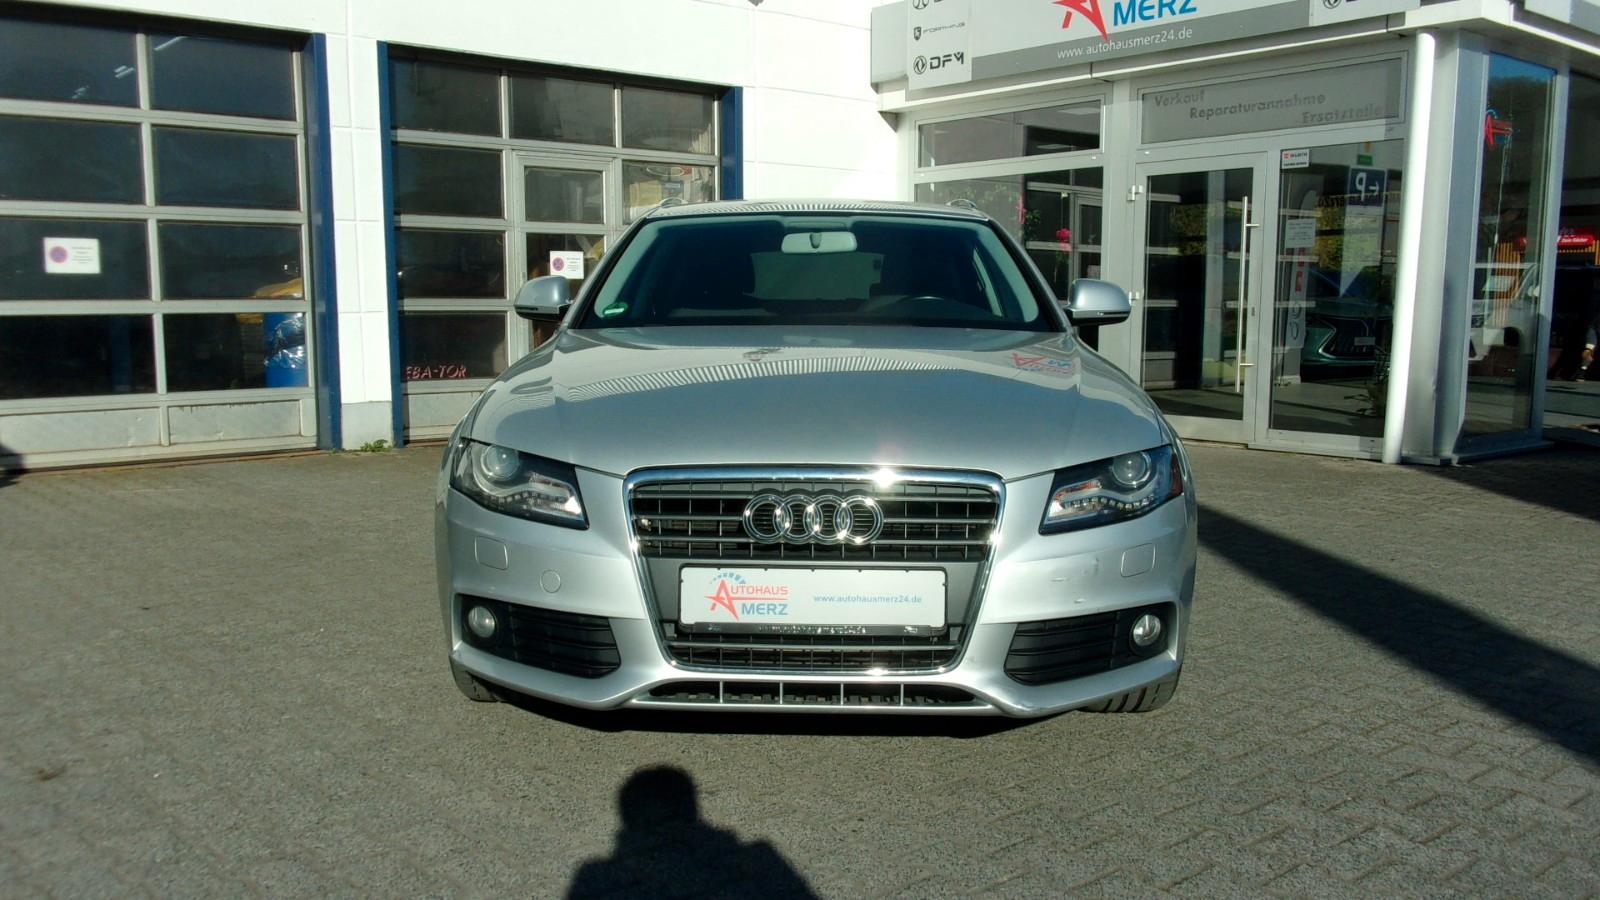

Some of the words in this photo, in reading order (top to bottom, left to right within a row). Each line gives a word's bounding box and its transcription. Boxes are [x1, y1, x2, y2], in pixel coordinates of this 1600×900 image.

[1113, 0, 1197, 26] MERZ
[1057, 27, 1193, 59] www.autohausmerz24.de
[1155, 91, 1205, 107] Verkauf
[1190, 93, 1326, 120] Reparaturannahme
[1303, 104, 1384, 124] Ersatzteile
[814, 594, 922, 603] www.autohausmerz24.de
[741, 603, 788, 615] MERZ
